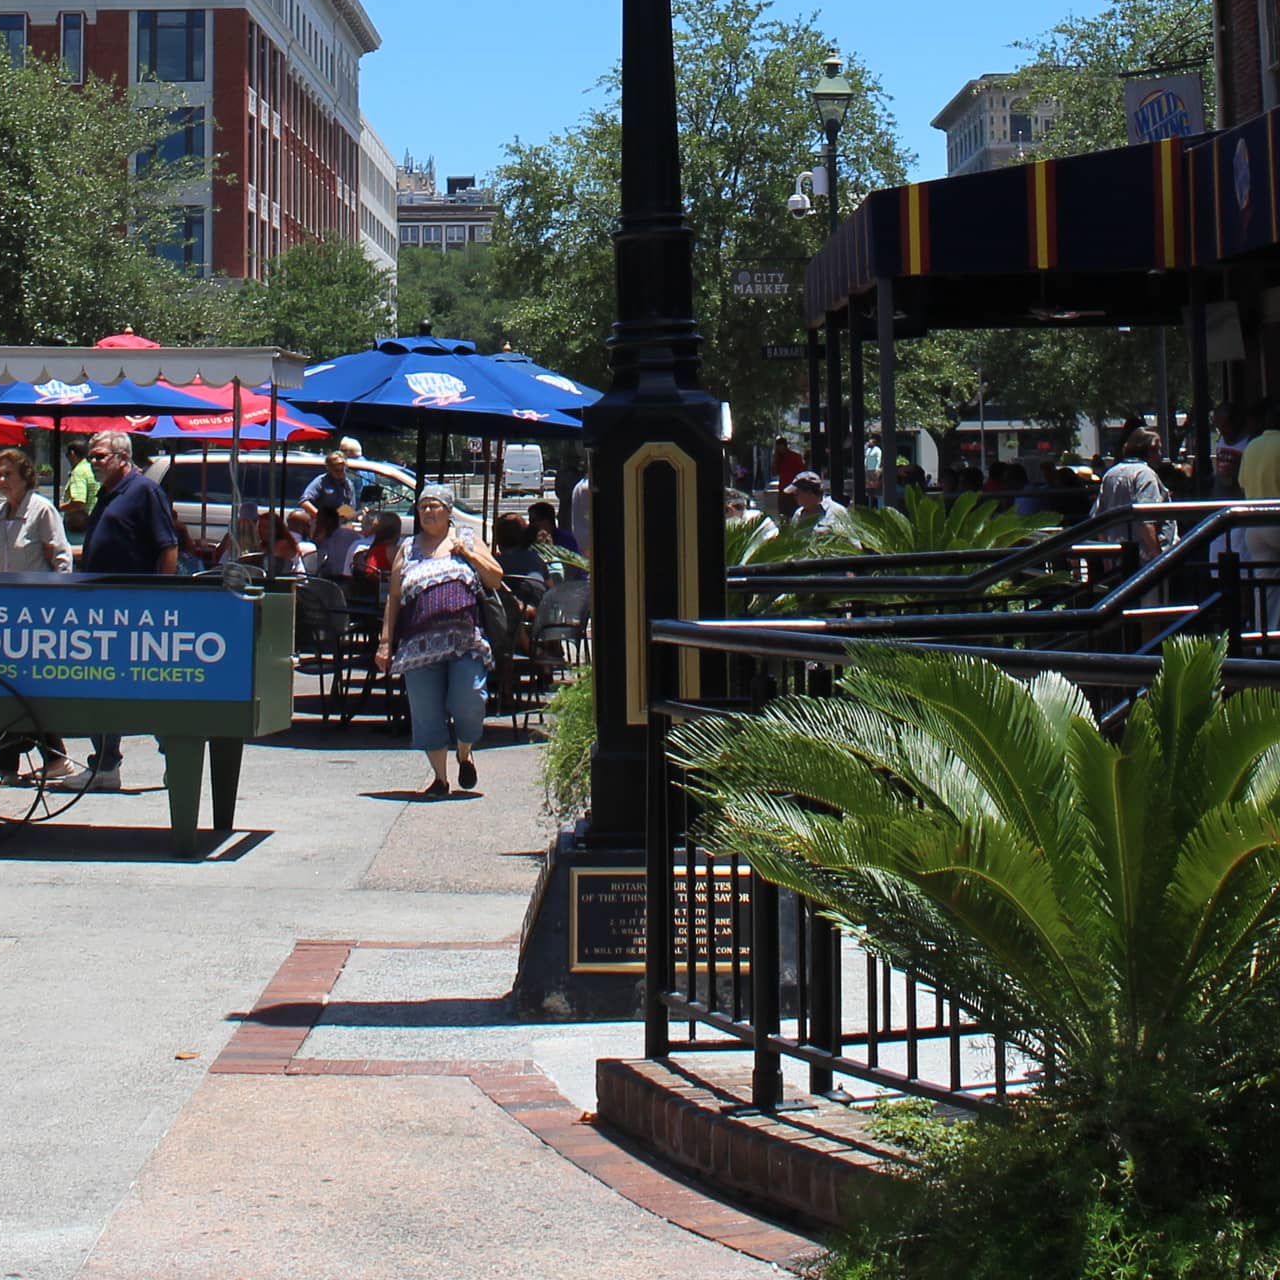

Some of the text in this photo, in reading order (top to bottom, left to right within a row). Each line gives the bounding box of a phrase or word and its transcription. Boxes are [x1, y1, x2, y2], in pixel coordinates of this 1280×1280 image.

[1134, 91, 1179, 134] WILD
[754, 273, 785, 283] CITY
[733, 283, 790, 294] MARKET
[189, 416, 210, 426] JOIN
[211, 415, 223, 425] US
[129, 631, 227, 664] INFO
[32, 665, 116, 682] LODGING
[132, 667, 206, 683] TICKETS
[581, 894, 593, 902] OF
[598, 894, 617, 902] THE
[713, 893, 732, 902] SAY
